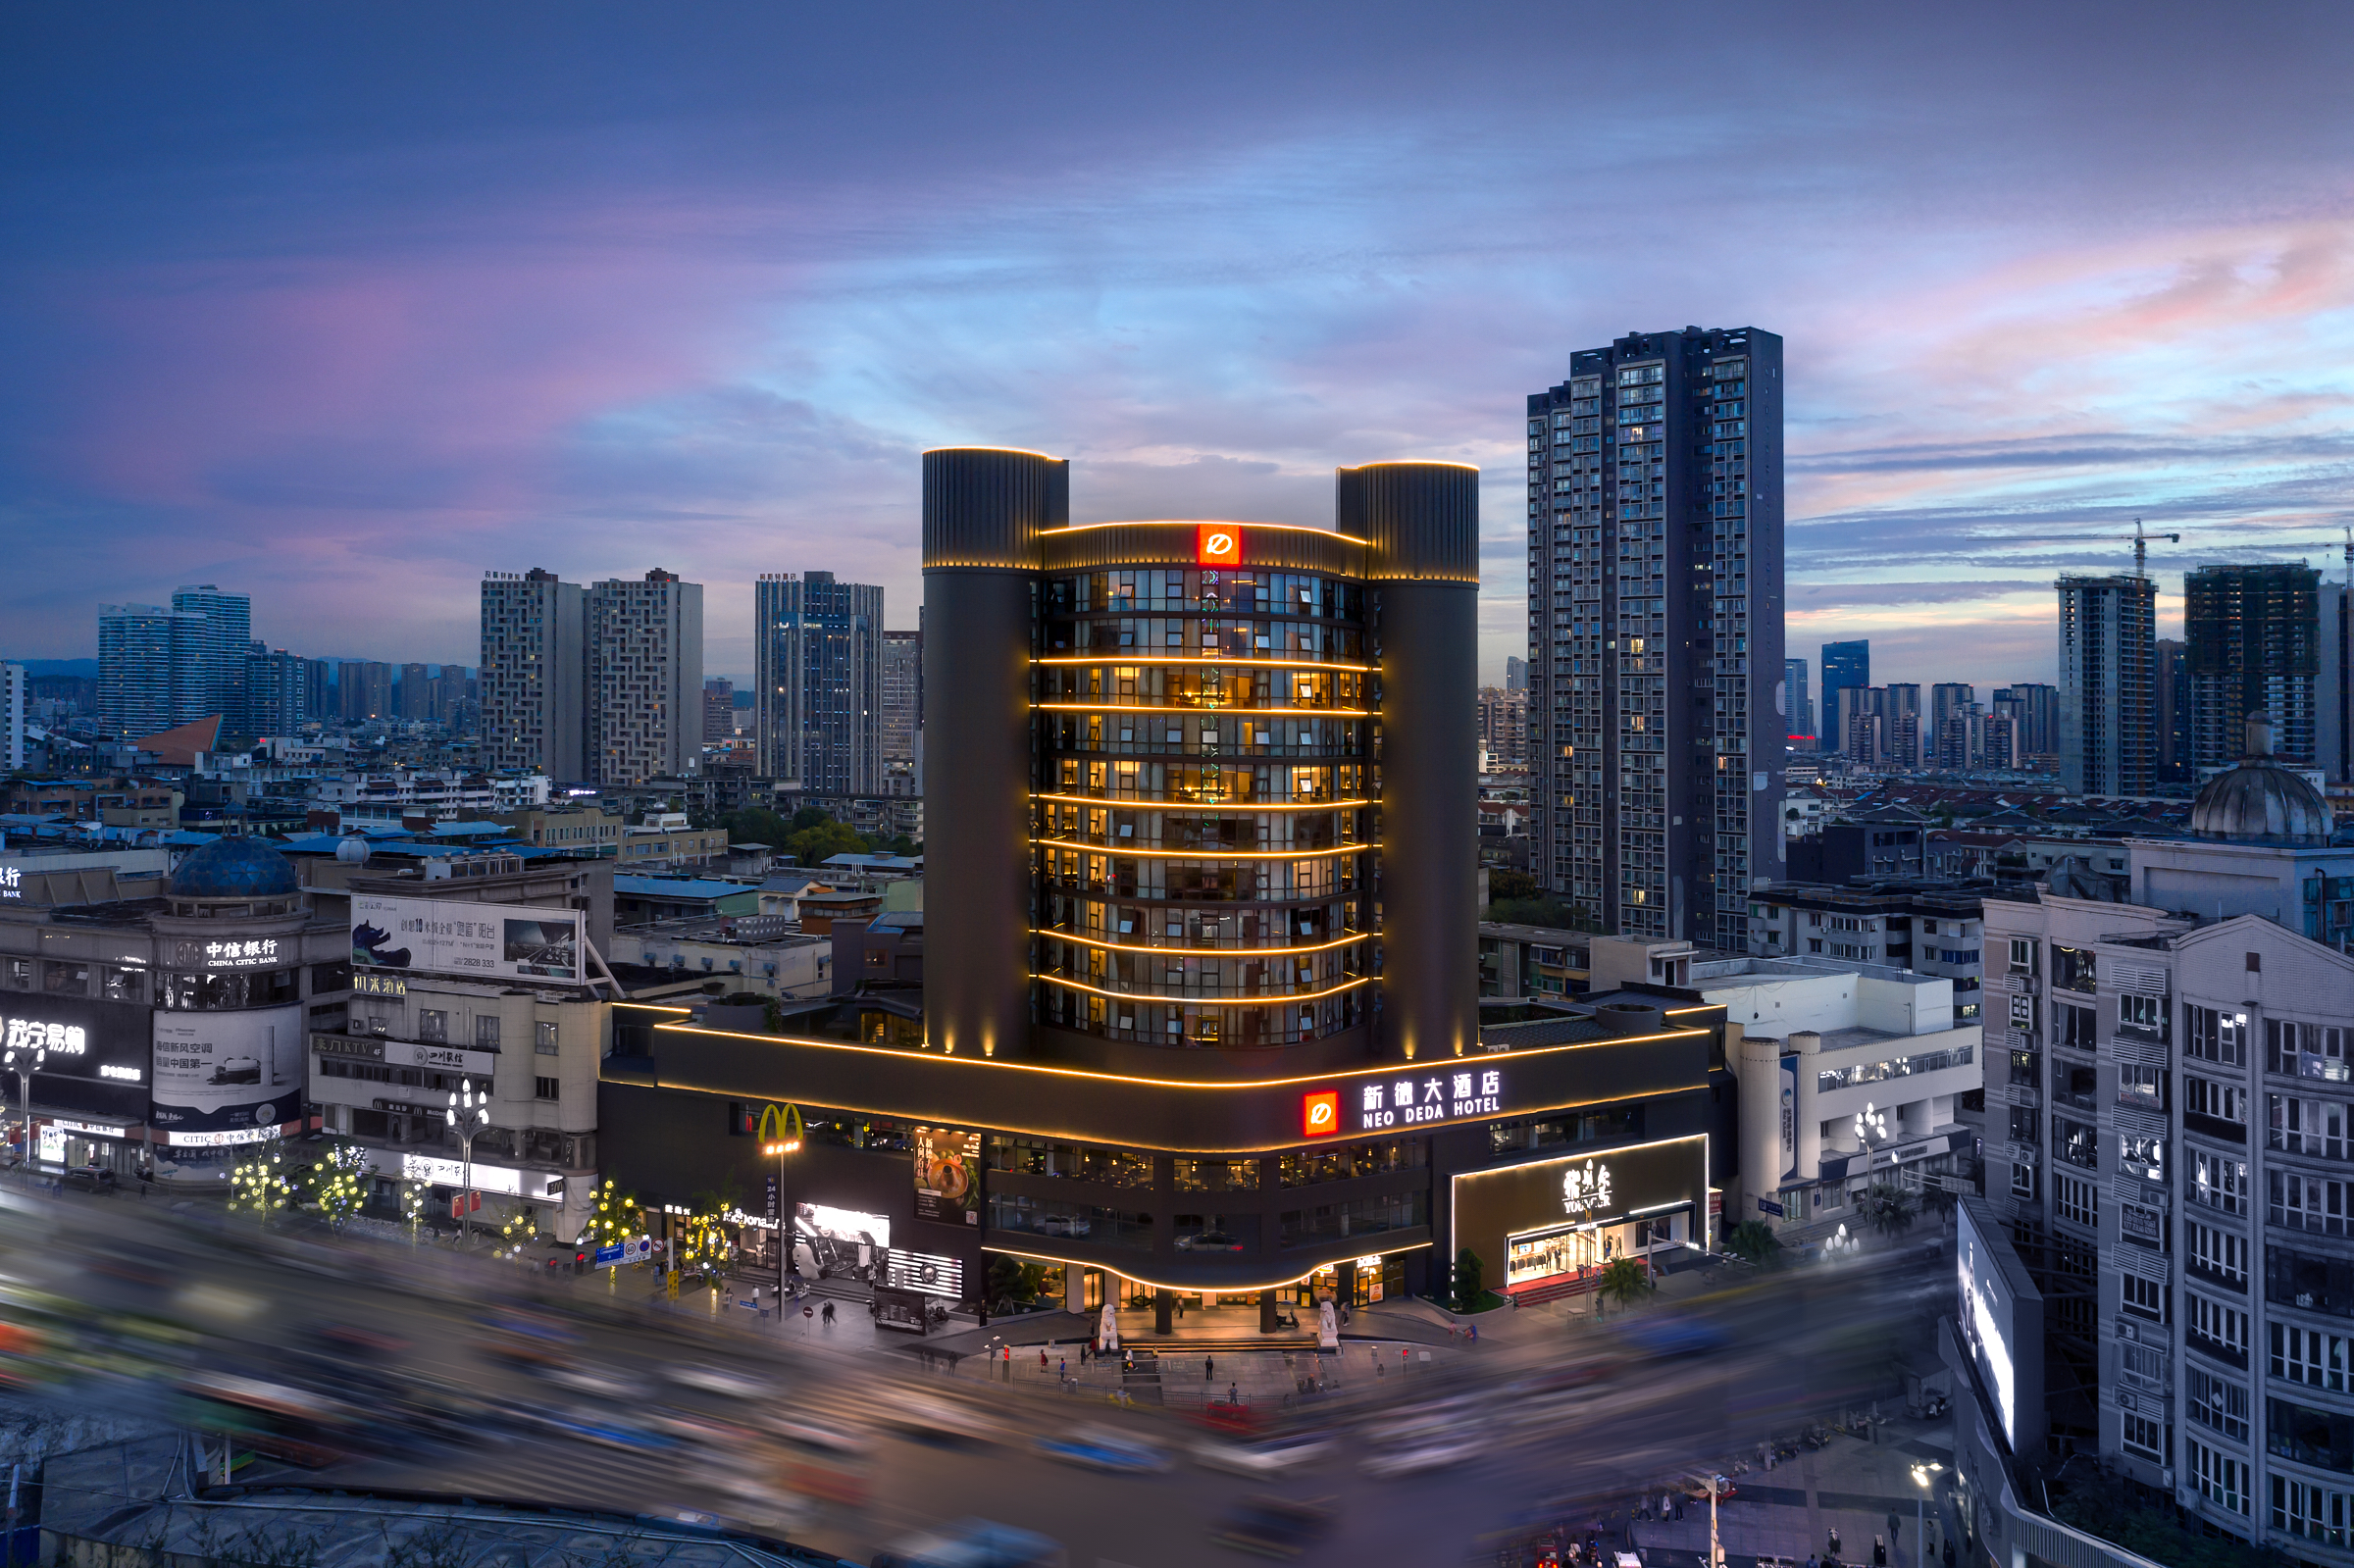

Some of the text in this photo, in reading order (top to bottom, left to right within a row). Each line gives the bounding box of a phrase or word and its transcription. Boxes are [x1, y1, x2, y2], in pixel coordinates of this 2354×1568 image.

[206, 939, 278, 959] 中信银行
[464, 958, 481, 967] 2828
[482, 959, 494, 968] 333
[7, 1019, 85, 1054] 苏宁易购
[1363, 1071, 1500, 1110] 新德大酒店
[1363, 1096, 1500, 1128] NEO DEDA HOTEL
